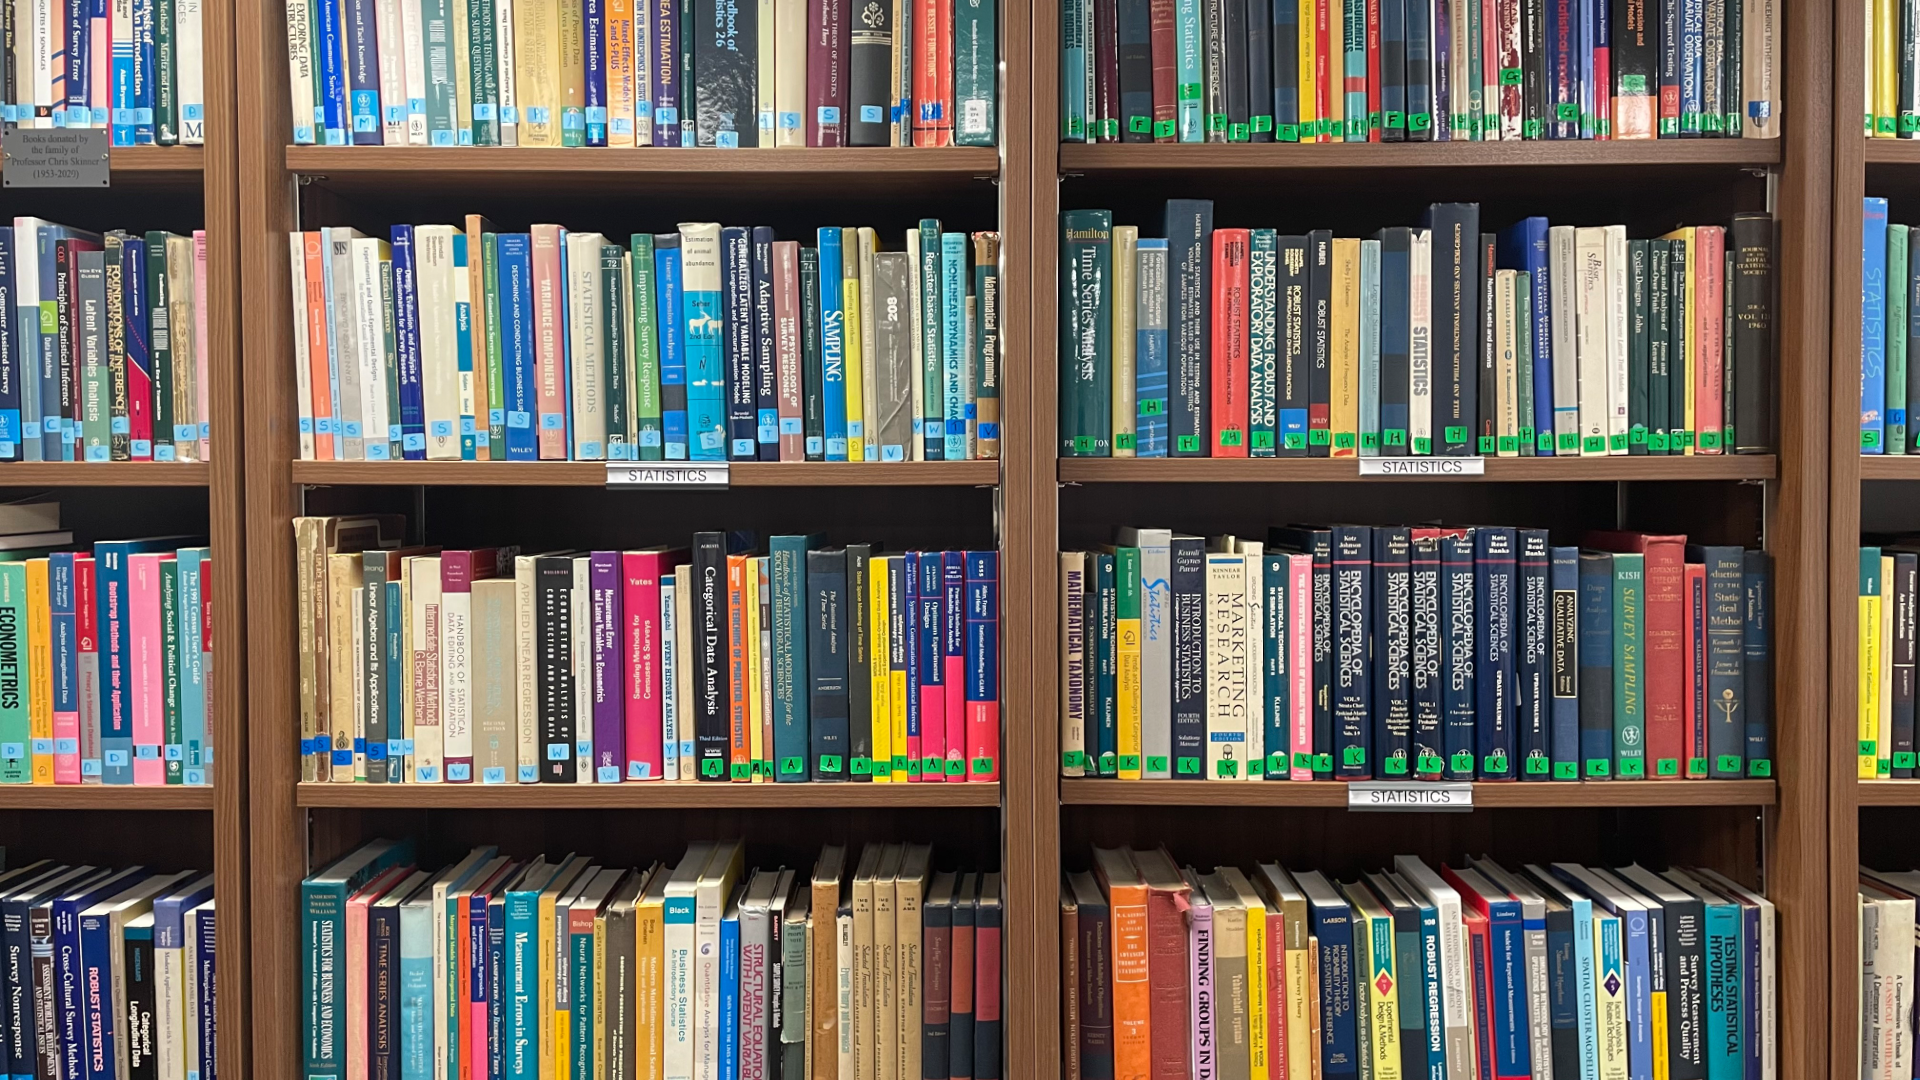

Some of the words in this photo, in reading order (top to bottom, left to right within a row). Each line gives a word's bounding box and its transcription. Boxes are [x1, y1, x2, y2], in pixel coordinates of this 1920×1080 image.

[71, 30, 80, 57] Survey
[73, 20, 80, 28] of
[287, 3, 298, 60] STRUCTURES
[296, 3, 307, 53] EXPLORING
[589, 17, 598, 70] Estimation
[1184, 17, 1196, 69] Statistics
[299, 56, 308, 78] DATA
[660, 19, 671, 85] ESTIMATION
[832, 51, 838, 59] OF
[23, 135, 46, 143] Books
[48, 135, 77, 143] donated
[80, 134, 88, 144] by
[45, 146, 69, 154] family
[737, 238, 747, 291] GENERALIZED
[1081, 246, 1096, 281] Time
[1318, 241, 1326, 265] HUBER
[1634, 251, 1643, 276] Cyclic
[56, 272, 67, 312] Principles
[541, 279, 552, 327] VARIANCE
[638, 270, 649, 323] Improving
[739, 293, 748, 322] LATENT
[758, 280, 769, 334] Adaptive
[924, 252, 935, 325] Register-based
[984, 276, 996, 330] Mathematical
[1081, 284, 1096, 324] Series
[1250, 251, 1263, 335] EXPLORATORY
[1264, 251, 1275, 350] UNDERSTANDING
[1634, 276, 1643, 307] Designs
[59, 313, 68, 324] of
[85, 300, 97, 331] Latent
[582, 271, 593, 350] STATISTICAL
[1635, 313, 1643, 334] John
[1866, 267, 1882, 378] STATISTICS
[44, 337, 52, 350] Data
[59, 326, 69, 366] Statistical
[87, 335, 100, 377] Variables
[639, 325, 650, 359] Survey
[740, 325, 749, 362] VARIABLE
[927, 328, 936, 371] Statistics
[983, 335, 996, 387] Programming
[1078, 327, 1096, 381] Analysis
[1251, 338, 1263, 370] DATA
[1317, 331, 1325, 369] STATISTICS
[1413, 327, 1428, 396] STATISTICS
[43, 352, 53, 378] Matching
[543, 330, 555, 397] COMPONENTS
[585, 352, 596, 413] METHODS
[741, 364, 751, 404] MODELING
[759, 337, 771, 396] Sampling
[1265, 353, 1275, 394] ROBUST
[60, 368, 70, 406] Inference
[86, 381, 100, 422] Analysis
[640, 362, 652, 407] Response
[1251, 373, 1263, 425] ANALYSIS
[548, 417, 556, 426] S
[1265, 394, 1275, 427] AND
[629, 470, 707, 481] STATISTICS
[1383, 461, 1462, 473] STATISTICS
[1618, 572, 1640, 580] KISH
[108, 581, 118, 619] Bootstrap
[521, 583, 530, 629] APPLIED
[705, 566, 716, 632] Categorical
[1067, 571, 1081, 655] MATHEMATICAL
[1181, 593, 1190, 641] BUSINESS
[1339, 571, 1350, 637] STATISTICAL
[1350, 570, 1362, 656] ENCYCLOPEDIA
[1387, 572, 1399, 640] STATISTICAL
[1398, 572, 1408, 658] ENCYCLOPEDIA
[1566, 595, 1574, 643] ANALYZING
[1623, 588, 1635, 640] SURVEY
[109, 621, 119, 652] Methods
[1191, 593, 1201, 674] INTRODUCTION
[1556, 595, 1564, 648] QUALITATIVE
[0, 607, 19, 709] ECONOMETRICS
[110, 655, 119, 668] and
[522, 631, 530, 672] LINEAR
[706, 635, 717, 664] Data
[1217, 593, 1230, 718] RESEARCH
[1232, 593, 1245, 718] MARKETING
[1340, 639, 1352, 688] SCIENCES
[1352, 659, 1363, 676] OF
[1388, 642, 1399, 690] SCIENCES
[1399, 661, 1409, 678] OF
[111, 670, 120, 688] their
[707, 668, 718, 715] Analysis
[1069, 660, 1083, 720] TAXONOMY
[1181, 644, 1191, 699] STATISTICS
[1192, 678, 1201, 693] TO
[1624, 644, 1636, 715] SAMPLING
[111, 690, 122, 730] Application
[522, 674, 531, 744] REGRESSION
[708, 762, 718, 773] A
[787, 760, 795, 769] A
[1184, 759, 1194, 772] K
[1629, 764, 1637, 772] K
[1371, 791, 1450, 803] STATISTICS
[321, 920, 332, 956] STATISTICS
[378, 944, 387, 968] TIME
[579, 938, 587, 964] Neural
[1197, 929, 1209, 986] FINDING
[1426, 935, 1438, 979] ROBUST
[9, 946, 20, 983] Survey
[61, 946, 73, 1009] Cross-Cultural
[322, 958, 332, 972] FOR
[514, 932, 527, 993] Measurement
[678, 950, 687, 994] Business
[1679, 956, 1689, 975] and
[1689, 955, 1699, 991] Survey
[1710, 935, 1723, 1012] HYPOTHESES
[1725, 935, 1737, 983] TESTING
[89, 967, 100, 1010] ROBUST
[322, 973, 332, 1004] BUSINESS
[378, 970, 387, 1001] SERIES
[579, 966, 587, 1002] Networks
[1680, 978, 1690, 1018] Process
[11, 987, 24, 1059] Nonresponse
[63, 1012, 75, 1041] Survey
[322, 1005, 332, 1019] AND
[378, 1003, 386, 1049] ANALYSIS
[515, 995, 527, 1026] Errors
[579, 1017, 587, 1042] Pattern
[678, 997, 687, 1042] Statistics
[1199, 991, 1210, 1047] GROUPS
[1428, 982, 1441, 1051] REGRESSION
[1691, 994, 1701, 1065] Measurement
[1726, 986, 1738, 1056] STATISTICAL
[91, 1012, 103, 1071] STATISTICS
[321, 1020, 332, 1059] ECONOMICS
[515, 1028, 526, 1036] in
[1679, 1021, 1691, 1060] Quality
[67, 1043, 77, 1080] Methods
[513, 1039, 528, 1074] Surveys
[1200, 1050, 1210, 1064] IN
